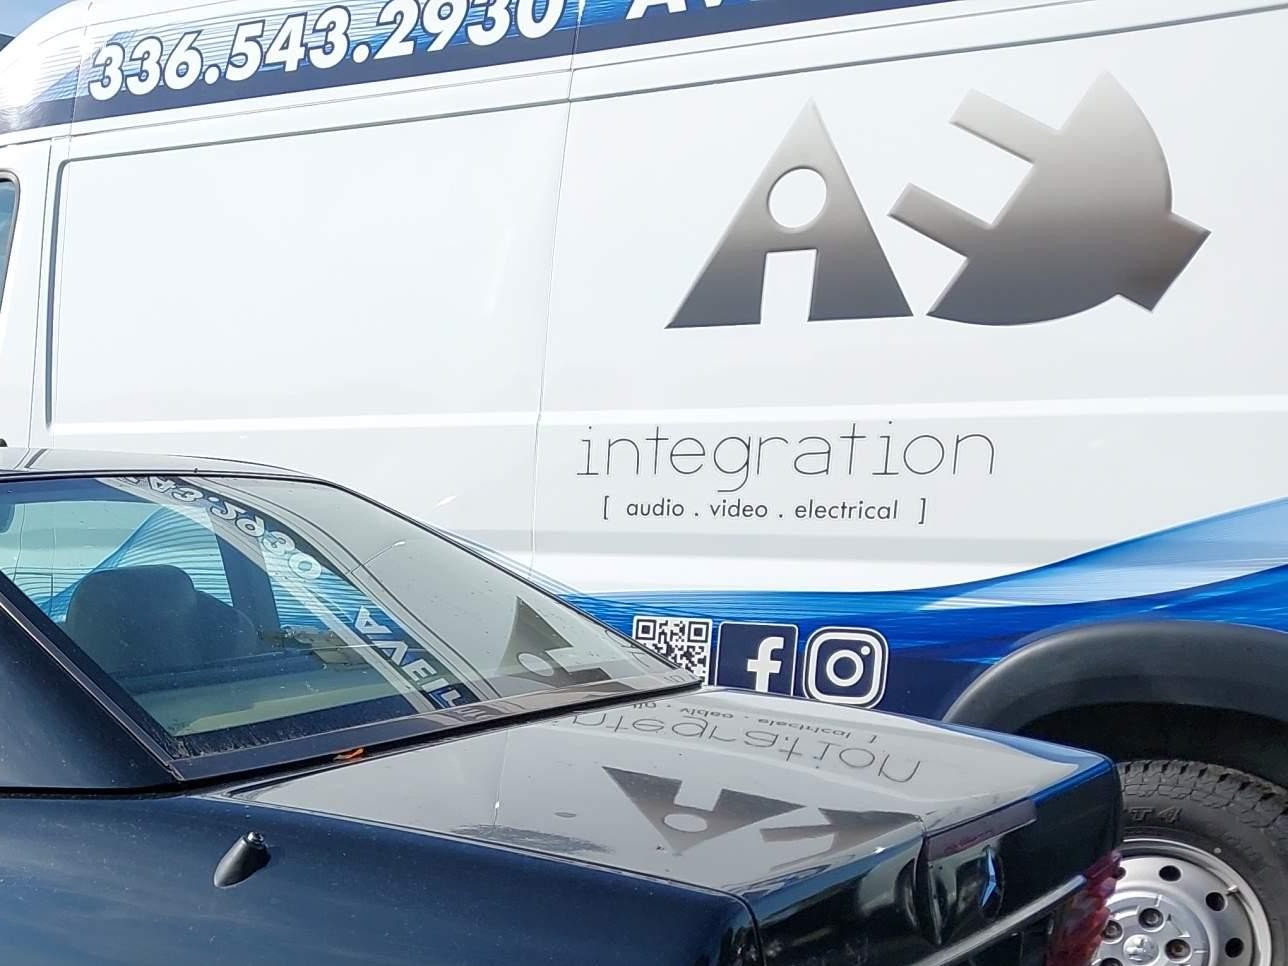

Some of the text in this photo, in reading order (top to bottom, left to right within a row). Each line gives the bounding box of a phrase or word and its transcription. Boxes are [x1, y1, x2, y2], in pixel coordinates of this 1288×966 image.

[88, 0, 566, 101] 336.543.2930
[575, 420, 997, 493] integration
[625, 498, 685, 518] audio
[709, 499, 768, 520] video
[794, 498, 899, 521] electrical
